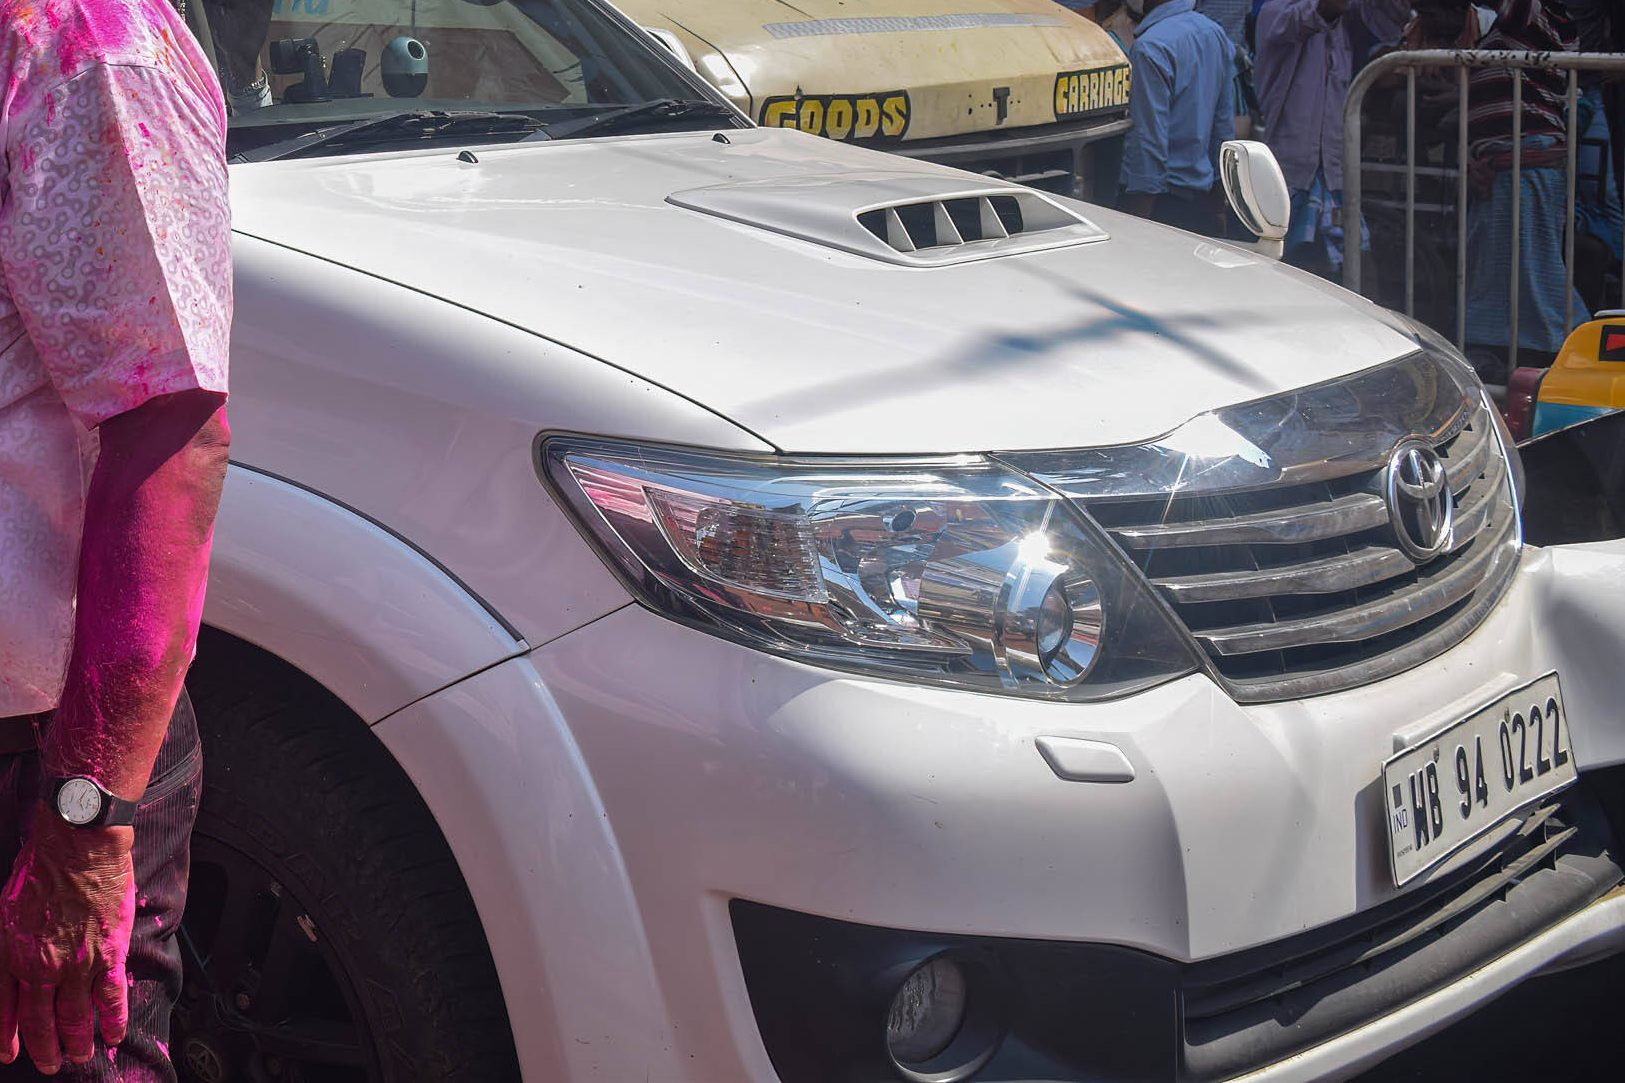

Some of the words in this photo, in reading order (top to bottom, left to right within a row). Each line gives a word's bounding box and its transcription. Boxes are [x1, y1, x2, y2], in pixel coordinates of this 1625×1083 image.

[765, 96, 908, 139] GOODS
[1054, 67, 1130, 114] CARRIAGE
[1409, 761, 1443, 852] WB
[1455, 734, 1488, 820] 94
[1500, 697, 1568, 793] 0222
[1392, 809, 1408, 834] IND
